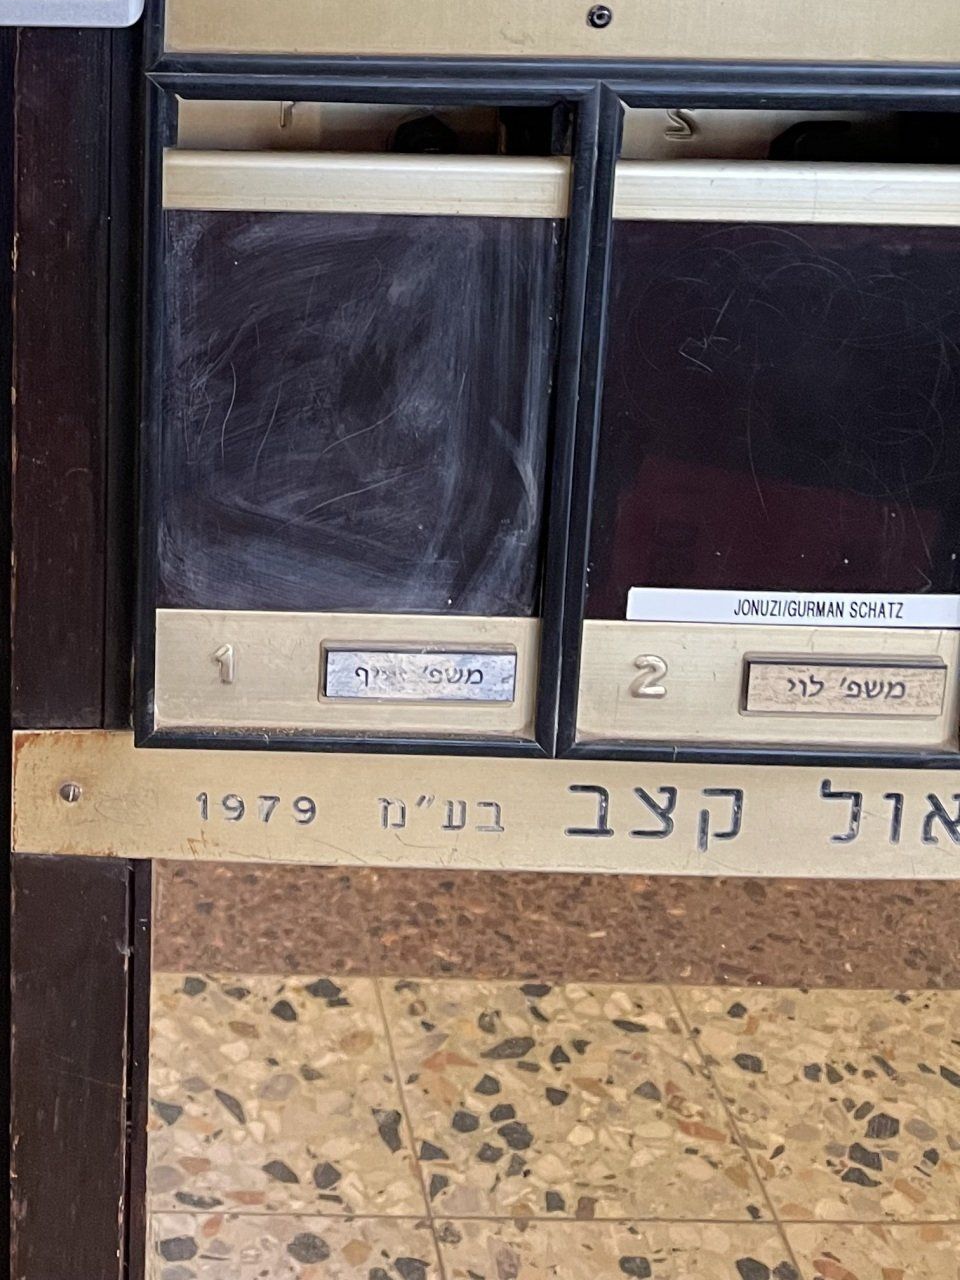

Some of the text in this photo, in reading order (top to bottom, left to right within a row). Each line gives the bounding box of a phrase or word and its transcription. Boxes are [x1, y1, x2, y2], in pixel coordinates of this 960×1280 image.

[733, 598, 904, 619] JONUZI/GURMAN SCHATZ
[212, 643, 235, 684] 1
[628, 654, 668, 700] 2
[786, 674, 825, 698] לוי
[195, 791, 318, 826] 1979
[564, 783, 745, 852] קצב
